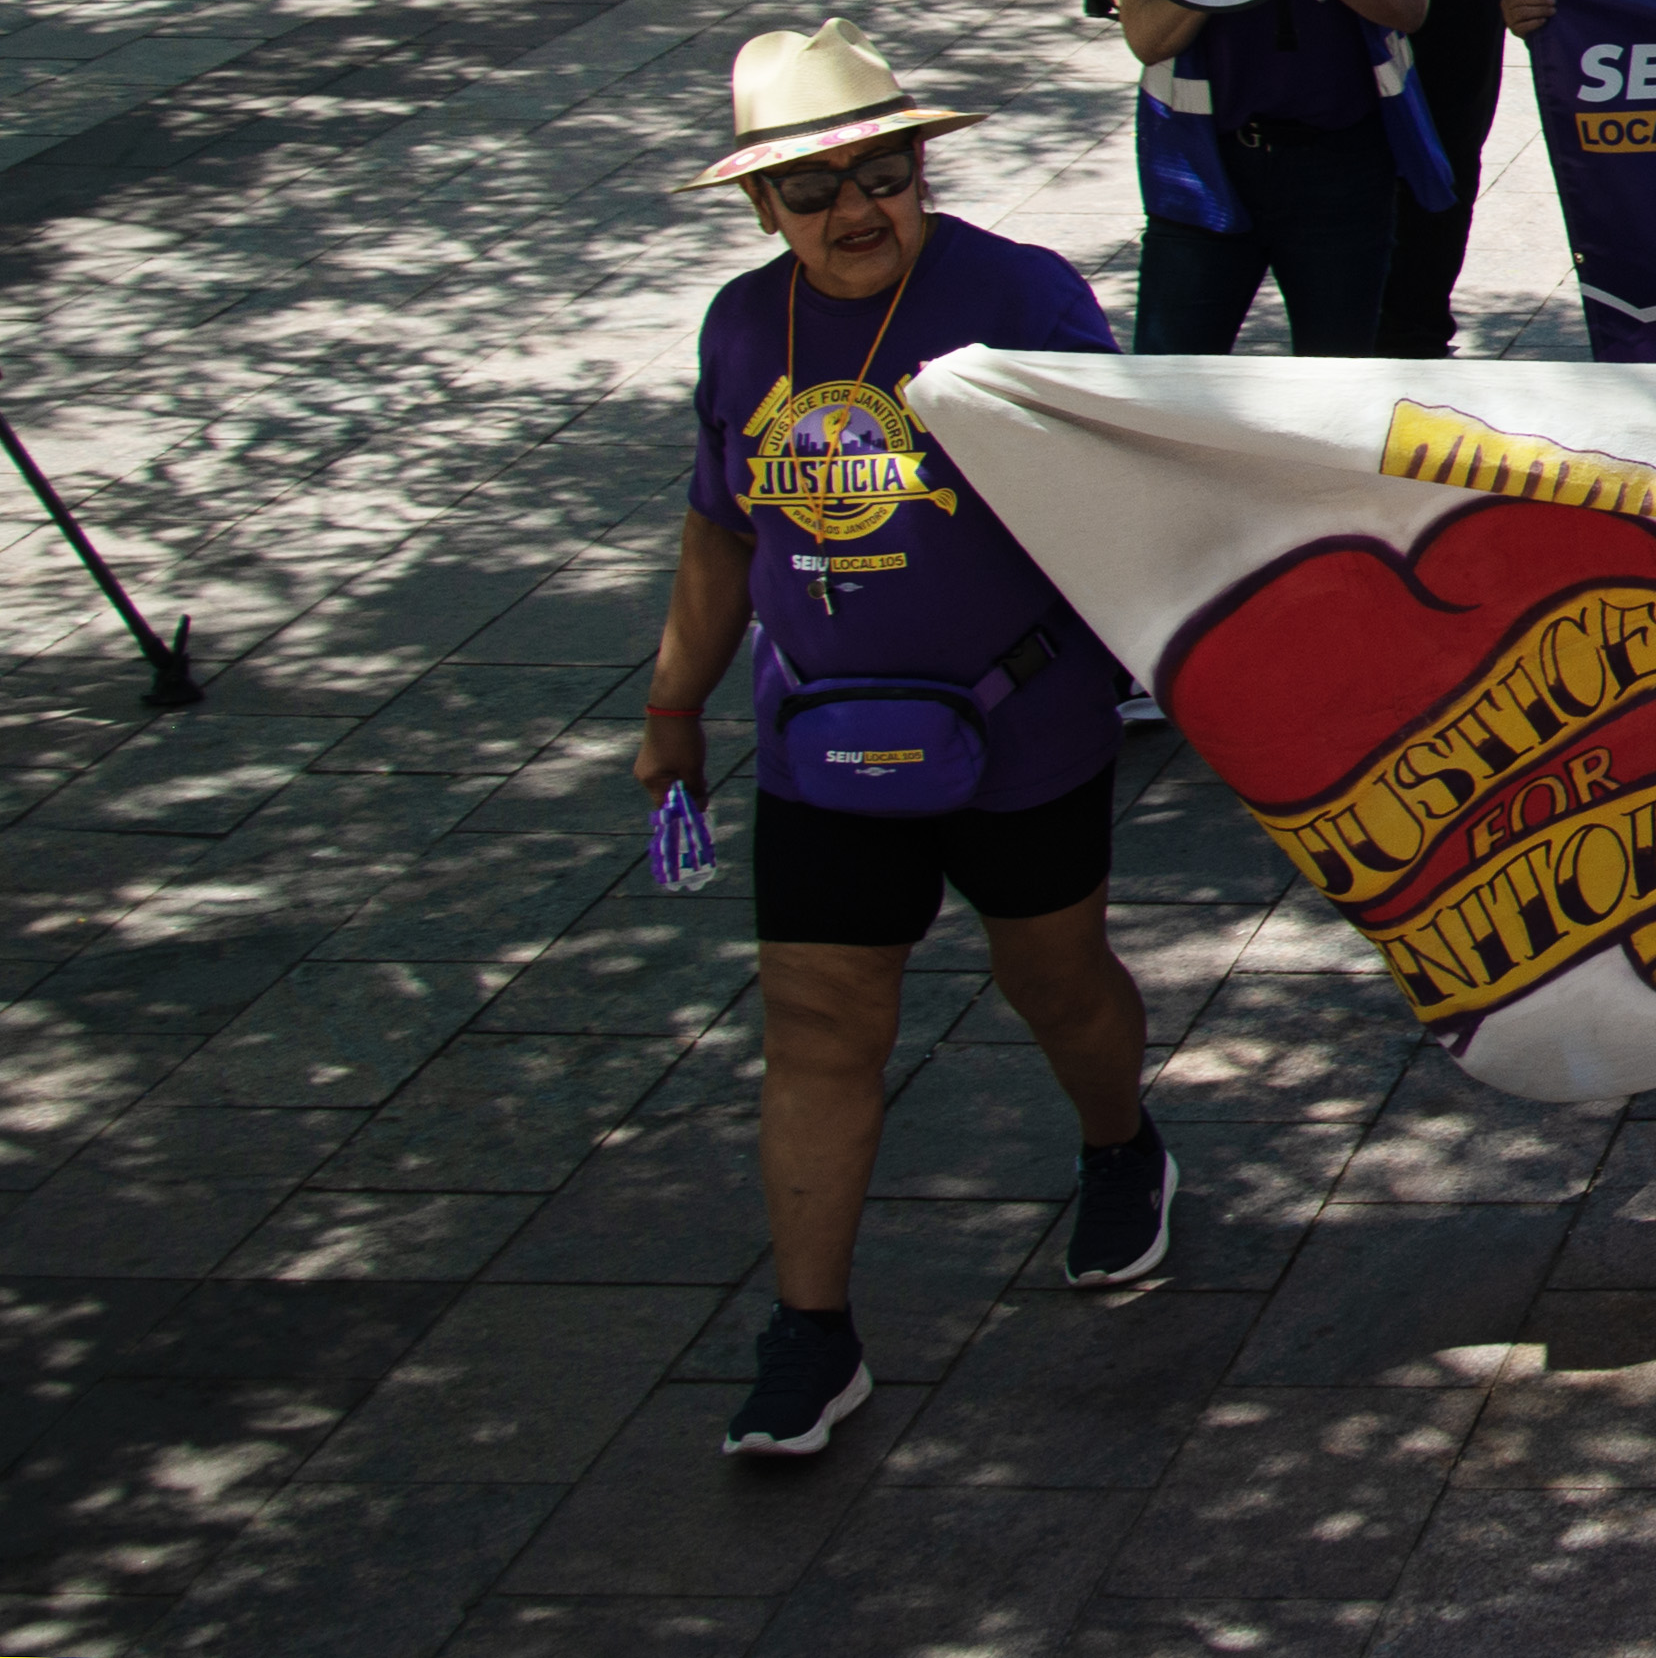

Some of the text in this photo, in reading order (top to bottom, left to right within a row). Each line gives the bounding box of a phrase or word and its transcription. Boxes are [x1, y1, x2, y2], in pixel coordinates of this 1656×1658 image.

[821, 389, 850, 403] FOR
[855, 394, 905, 450] JANITORS
[760, 457, 906, 494] JUSTICIA
[843, 507, 888, 535] JANITORS
[791, 554, 905, 572] SEIU LOCAL 105
[826, 750, 922, 763] SEIU LOCAL 105
[1470, 745, 1622, 864] FOR
